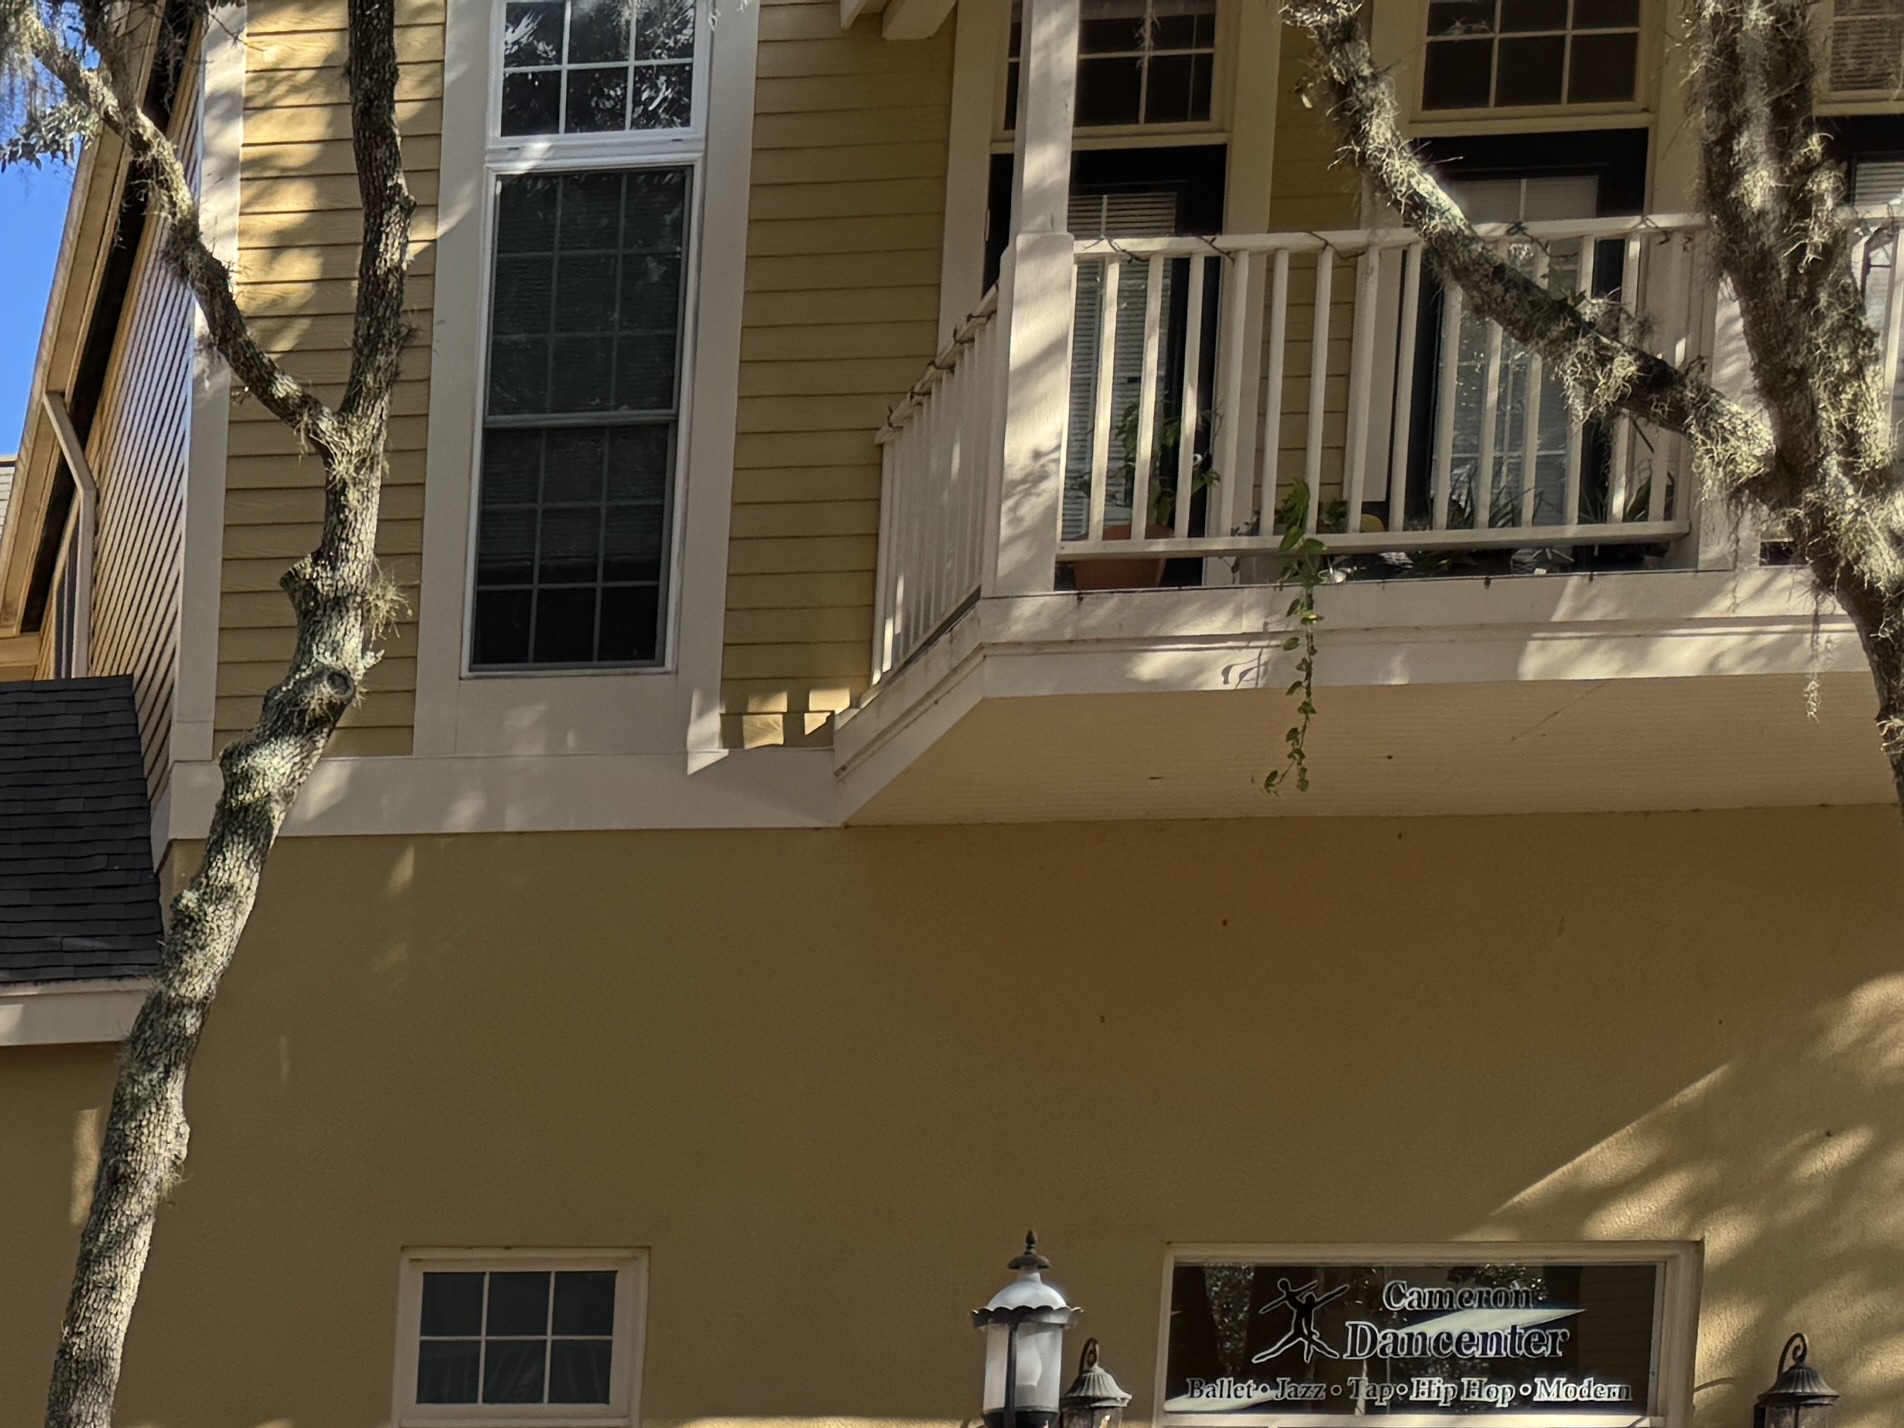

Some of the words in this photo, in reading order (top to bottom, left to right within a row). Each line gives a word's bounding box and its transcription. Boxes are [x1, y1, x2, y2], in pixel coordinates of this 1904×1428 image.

[1383, 1281, 1535, 1312] Cameron
[1343, 1321, 1570, 1361] Dancenter
[1186, 1377, 1257, 1400] Ballet
[1274, 1378, 1327, 1401] Jazz
[1348, 1378, 1393, 1404] Tap
[1410, 1378, 1458, 1405] Hip
[1460, 1378, 1515, 1407] Hop
[1533, 1377, 1632, 1401] Modern
